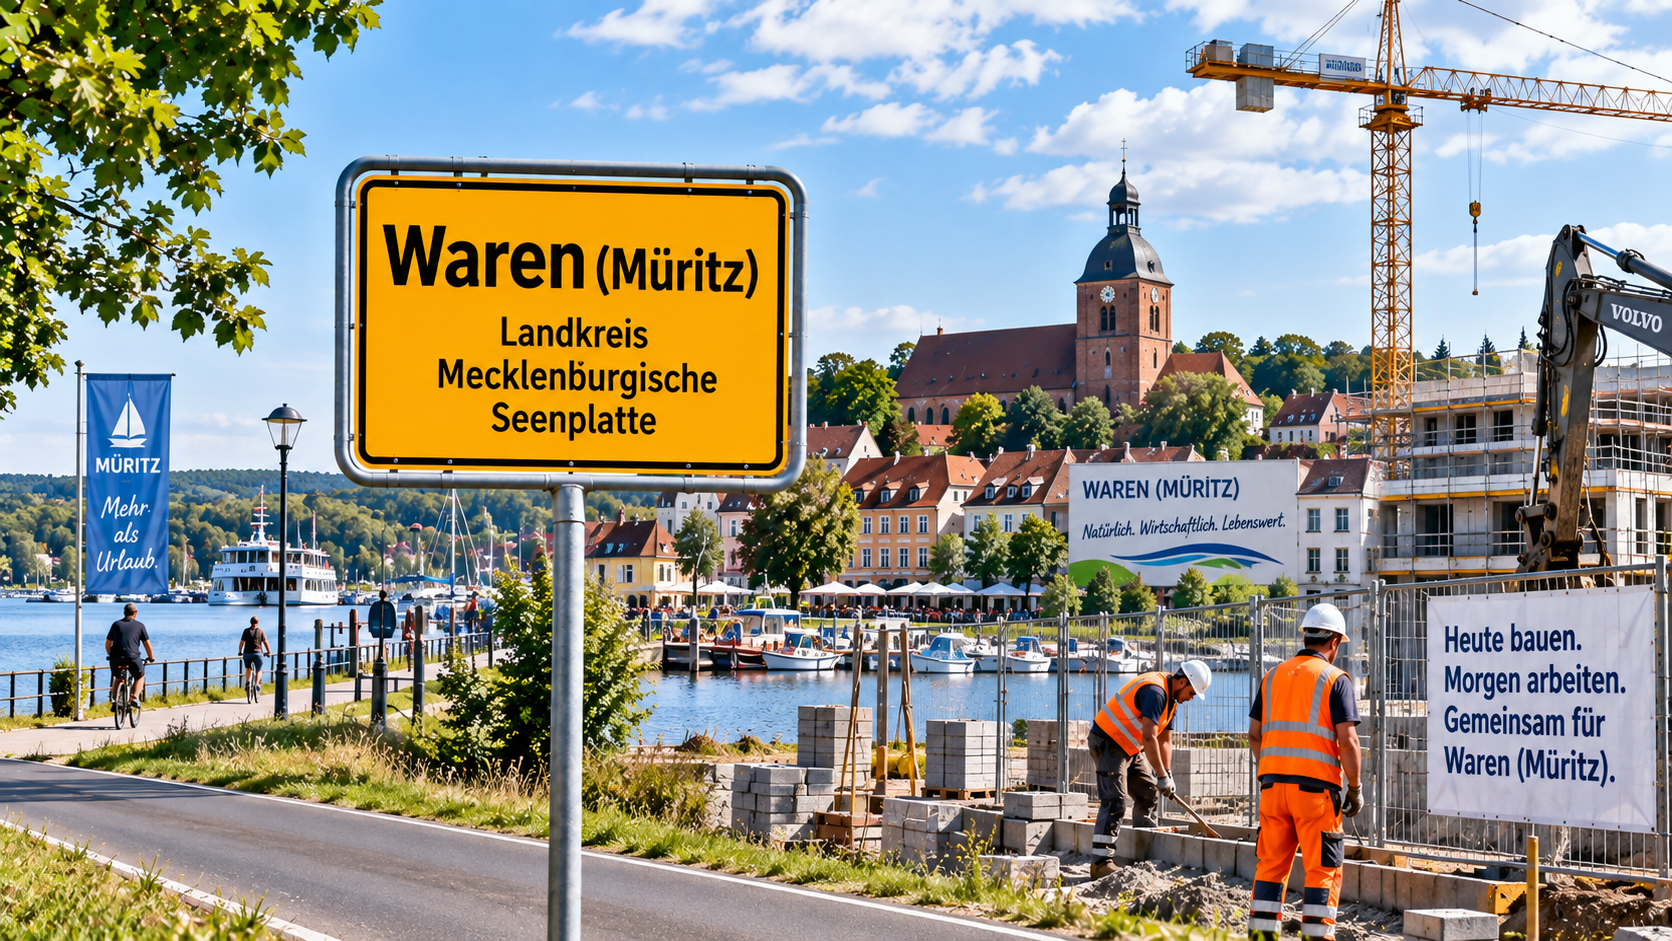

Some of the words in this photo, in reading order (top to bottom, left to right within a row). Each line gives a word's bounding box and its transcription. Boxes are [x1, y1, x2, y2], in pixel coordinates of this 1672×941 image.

[382, 224, 585, 289] Waren
[596, 244, 759, 300] (Müritz)
[501, 316, 648, 349] Landkreis
[1610, 302, 1663, 334] VOLVO
[438, 358, 718, 399] Mecklenburgische
[491, 401, 657, 441] Seenplatte
[95, 453, 161, 474] MÜRITZ
[1082, 479, 1150, 500] WAREN
[113, 521, 139, 544] als
[1082, 519, 1136, 541] Natürlich.
[1139, 514, 1219, 539] Wirtschaftlich.
[1221, 511, 1287, 532] Lebenswert.
[96, 547, 159, 573] Urlaub.
[1444, 625, 1505, 654] Heute
[1510, 622, 1583, 653] bauen.
[1444, 665, 1521, 701] Morgen
[1526, 663, 1627, 695] arbeiten.
[1443, 704, 1566, 737] Gemeinsam
[1571, 705, 1606, 738] für
[1443, 745, 1511, 777] Waren
[1516, 746, 1616, 789] (Müritz).
